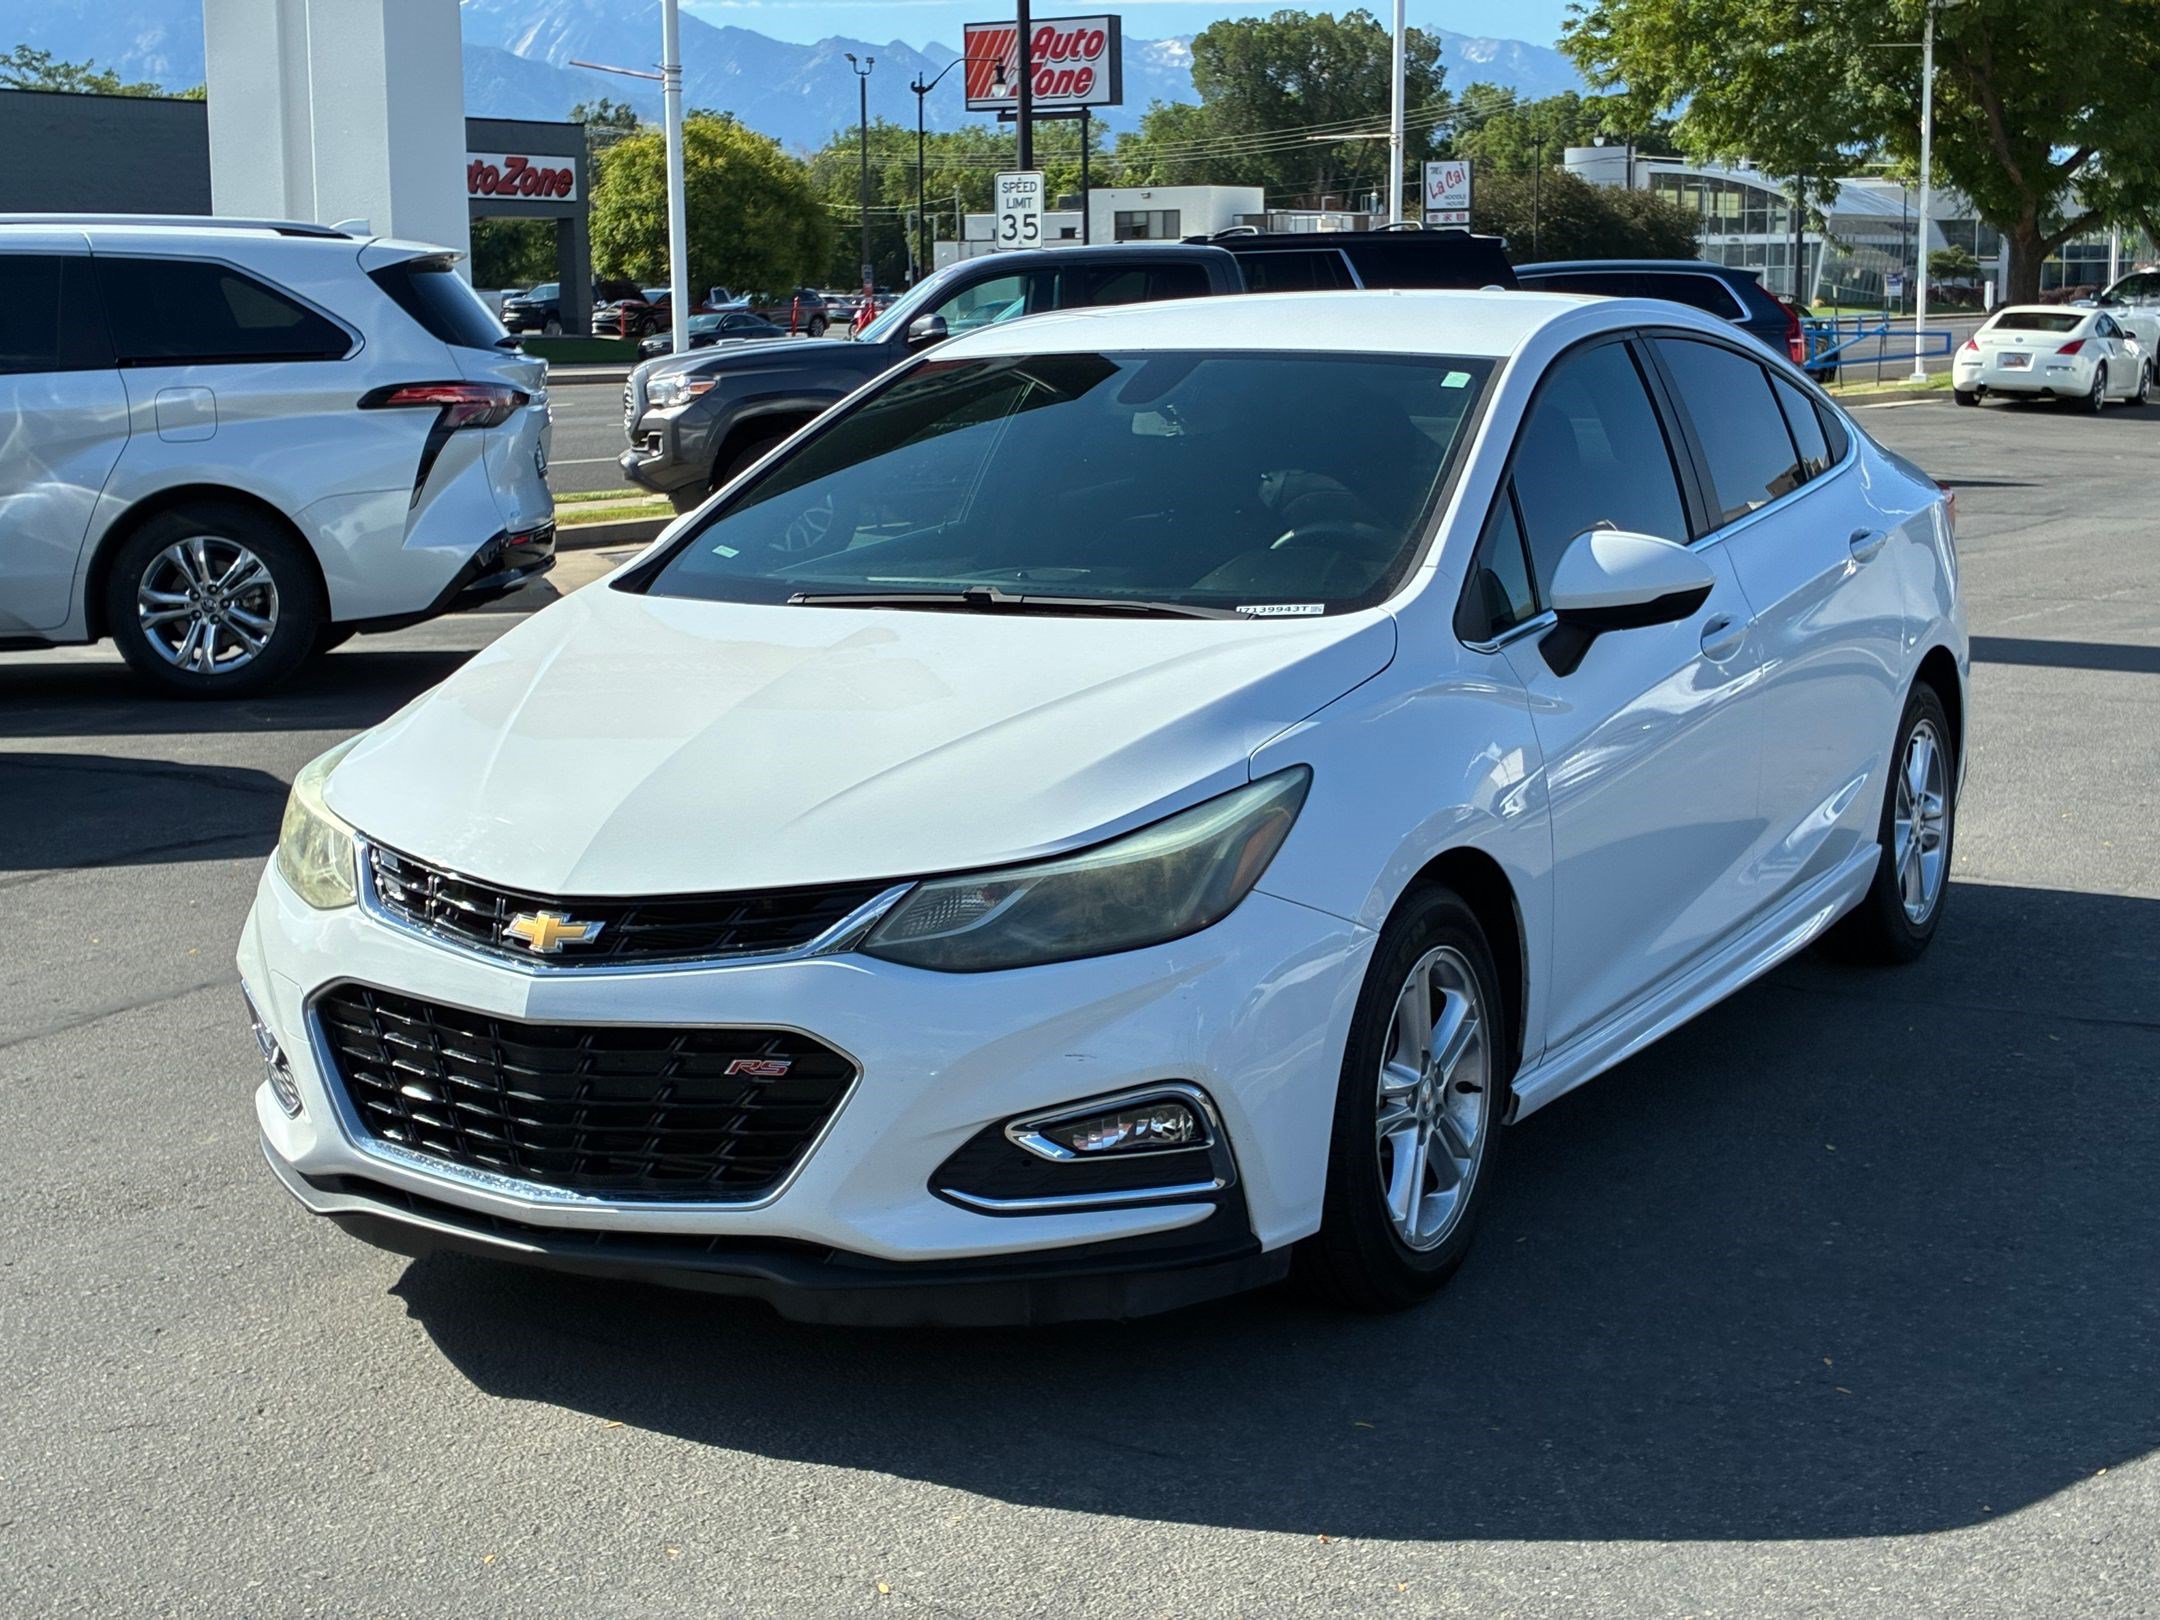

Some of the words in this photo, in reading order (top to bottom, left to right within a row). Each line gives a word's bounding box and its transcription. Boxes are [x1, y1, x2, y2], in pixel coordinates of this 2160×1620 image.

[1030, 26, 1106, 61] Auto
[467, 156, 573, 198] toZone
[1001, 181, 1038, 194] SPEED
[1428, 180, 1446, 200] La
[1446, 162, 1467, 189] Cai
[1006, 197, 1033, 210] LIMIT
[1001, 213, 1039, 241] 35
[723, 1059, 792, 1076] RS
